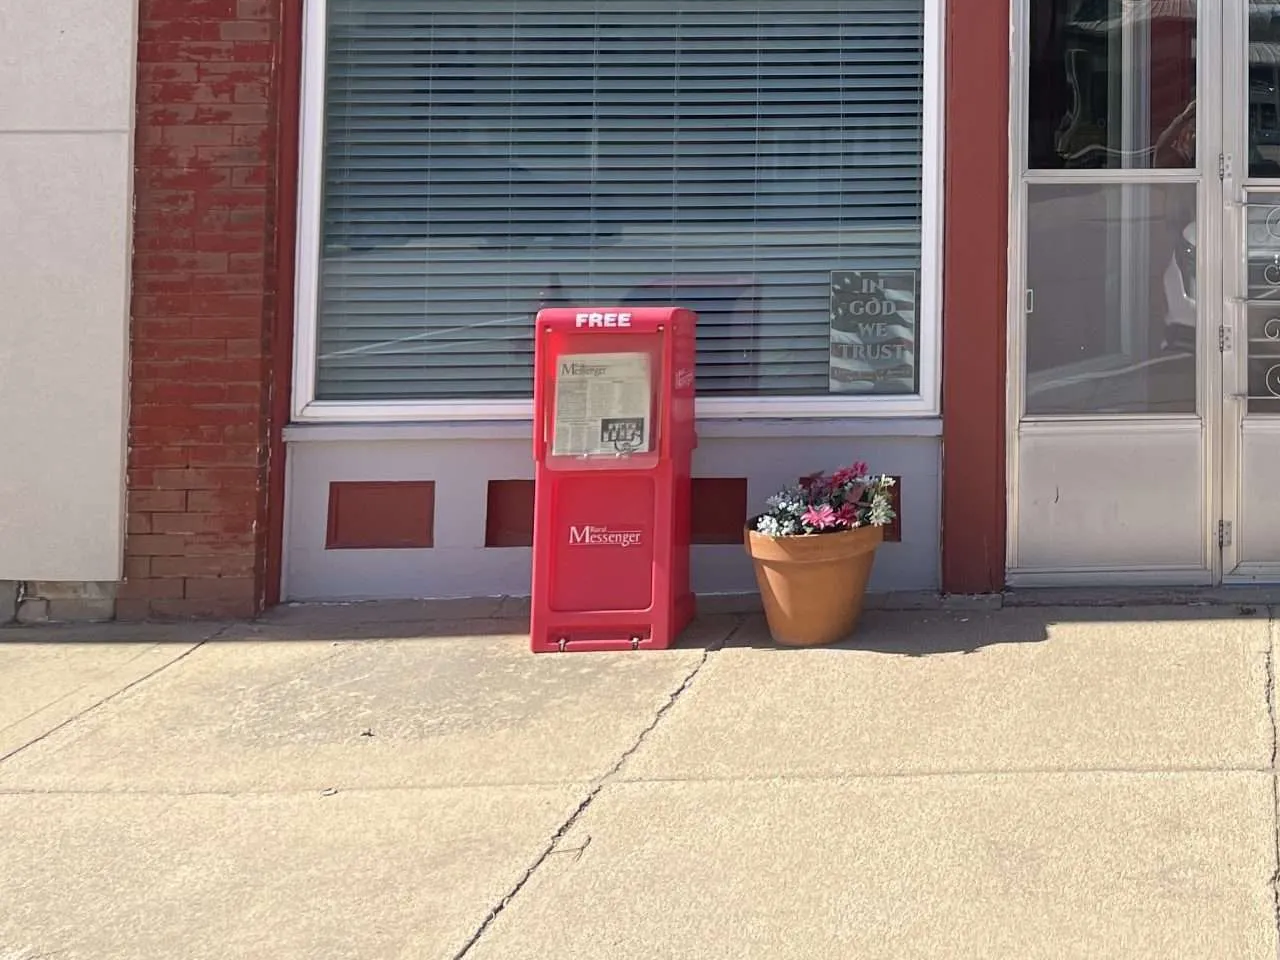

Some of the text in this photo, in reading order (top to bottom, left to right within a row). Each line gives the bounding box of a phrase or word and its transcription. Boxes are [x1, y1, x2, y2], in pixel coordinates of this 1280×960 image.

[861, 278, 885, 293] IN
[849, 299, 897, 316] GOD
[575, 313, 632, 328] FREE
[857, 322, 889, 337] WE
[840, 344, 905, 360] TRUST
[569, 525, 641, 547] Messenger
